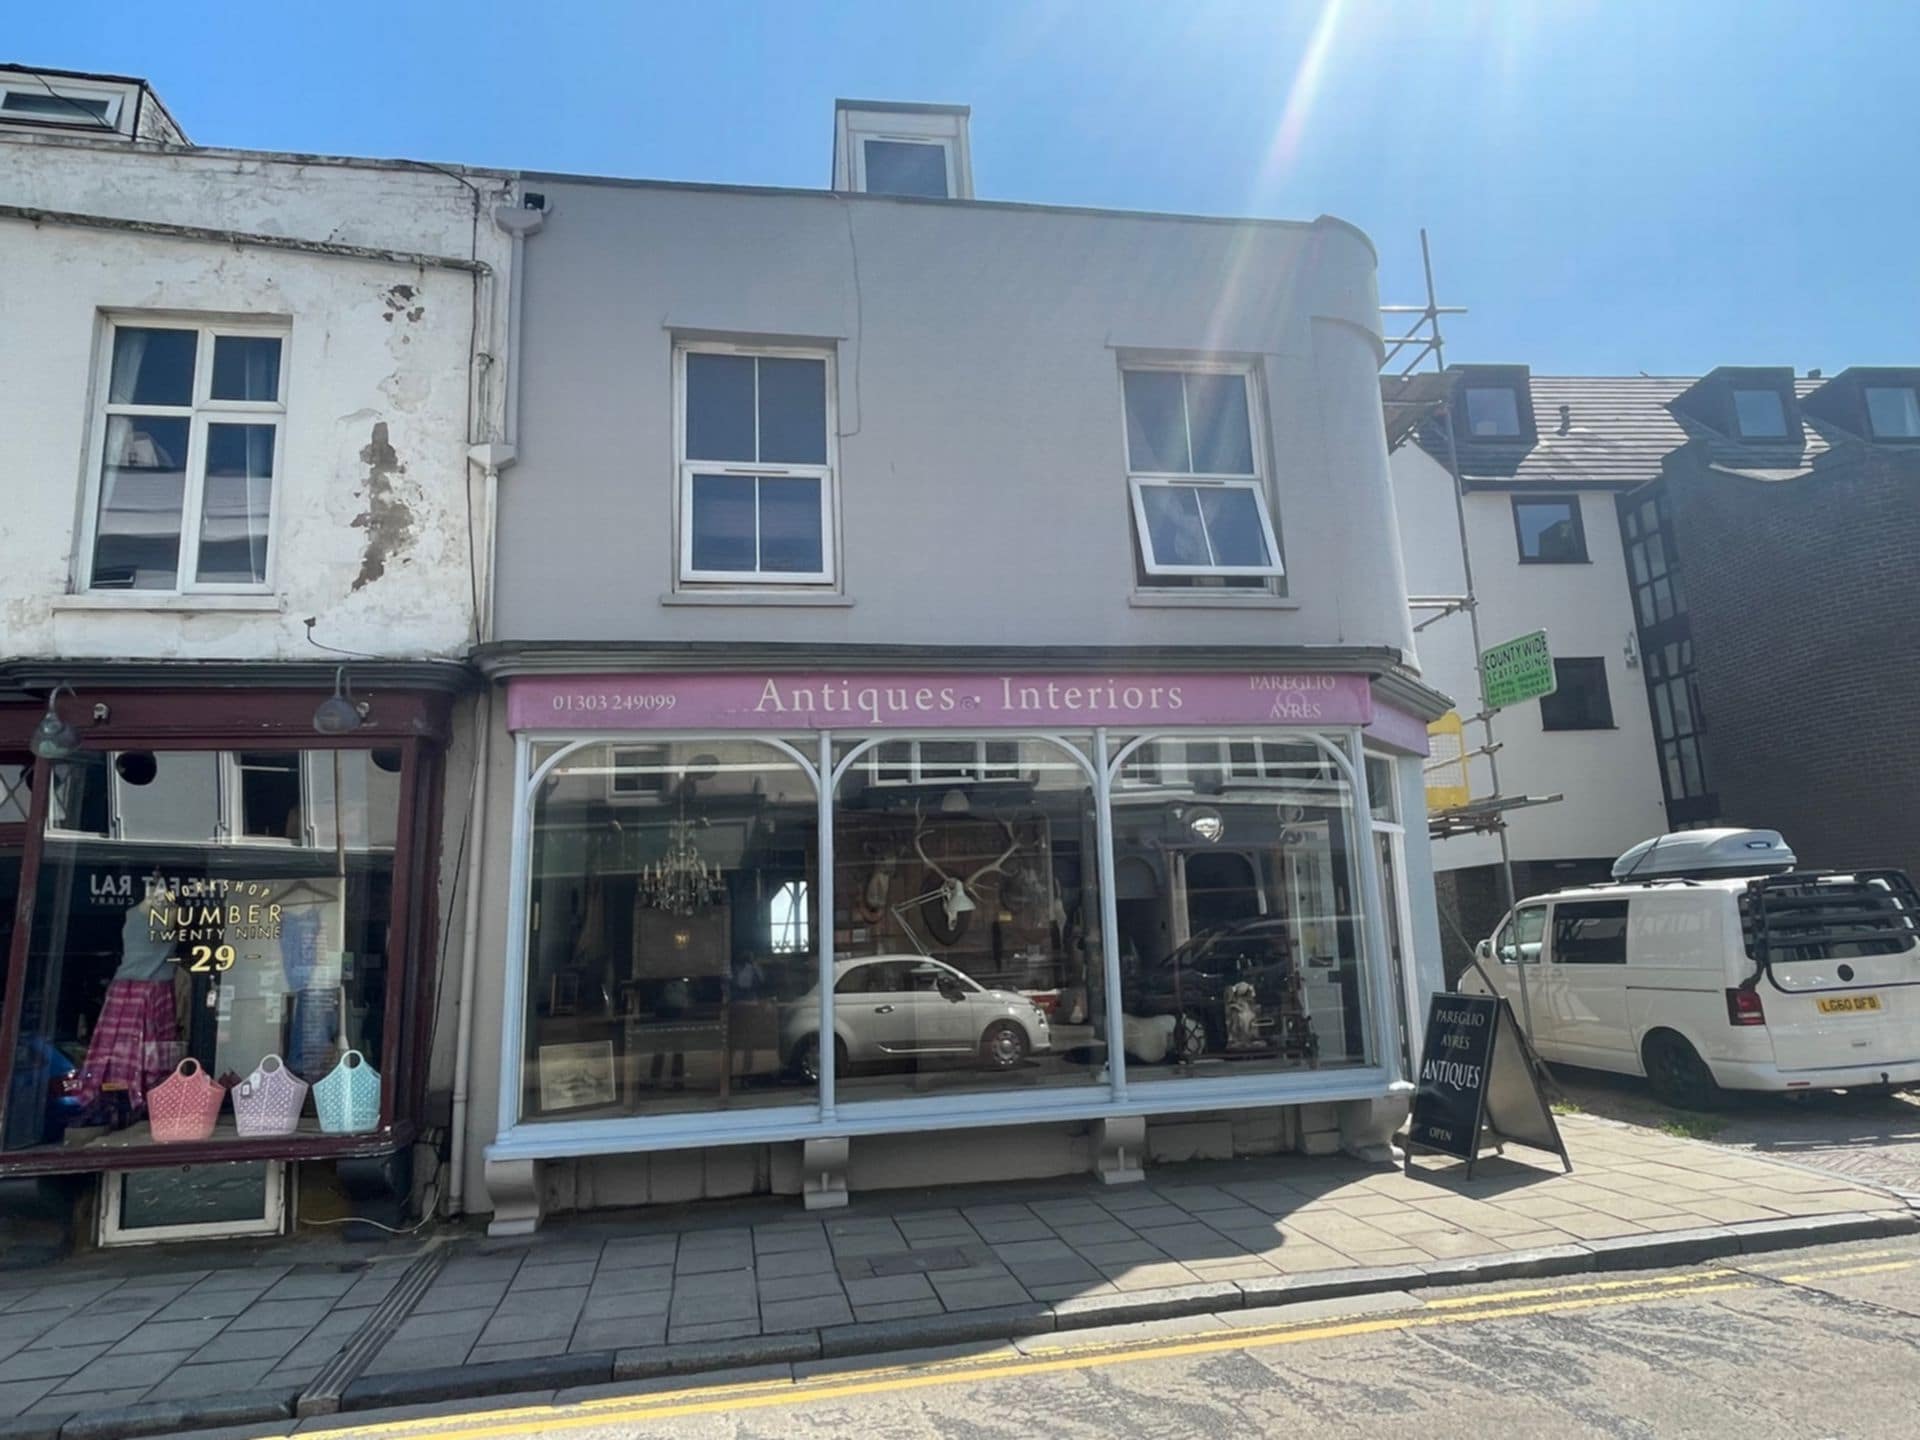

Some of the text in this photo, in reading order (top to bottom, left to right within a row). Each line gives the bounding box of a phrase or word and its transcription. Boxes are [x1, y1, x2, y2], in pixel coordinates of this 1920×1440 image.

[1487, 655, 1548, 684] SCAFFOLDING
[1249, 675, 1336, 690] PAREGLIO
[552, 694, 677, 711] 01303 249099
[754, 677, 1184, 724] Antiques Interiors
[1269, 703, 1322, 719] AYRES
[164, 879, 270, 902] WORKSHOP
[149, 904, 282, 927] NUMBER
[149, 926, 281, 942] TWENTY NINE
[189, 944, 237, 973] 29
[1435, 1009, 1485, 1027] PAREGLIO
[1440, 1034, 1471, 1050] AYRES
[1422, 1058, 1481, 1091] ANTIQUES
[1428, 1126, 1453, 1141] OPEN
